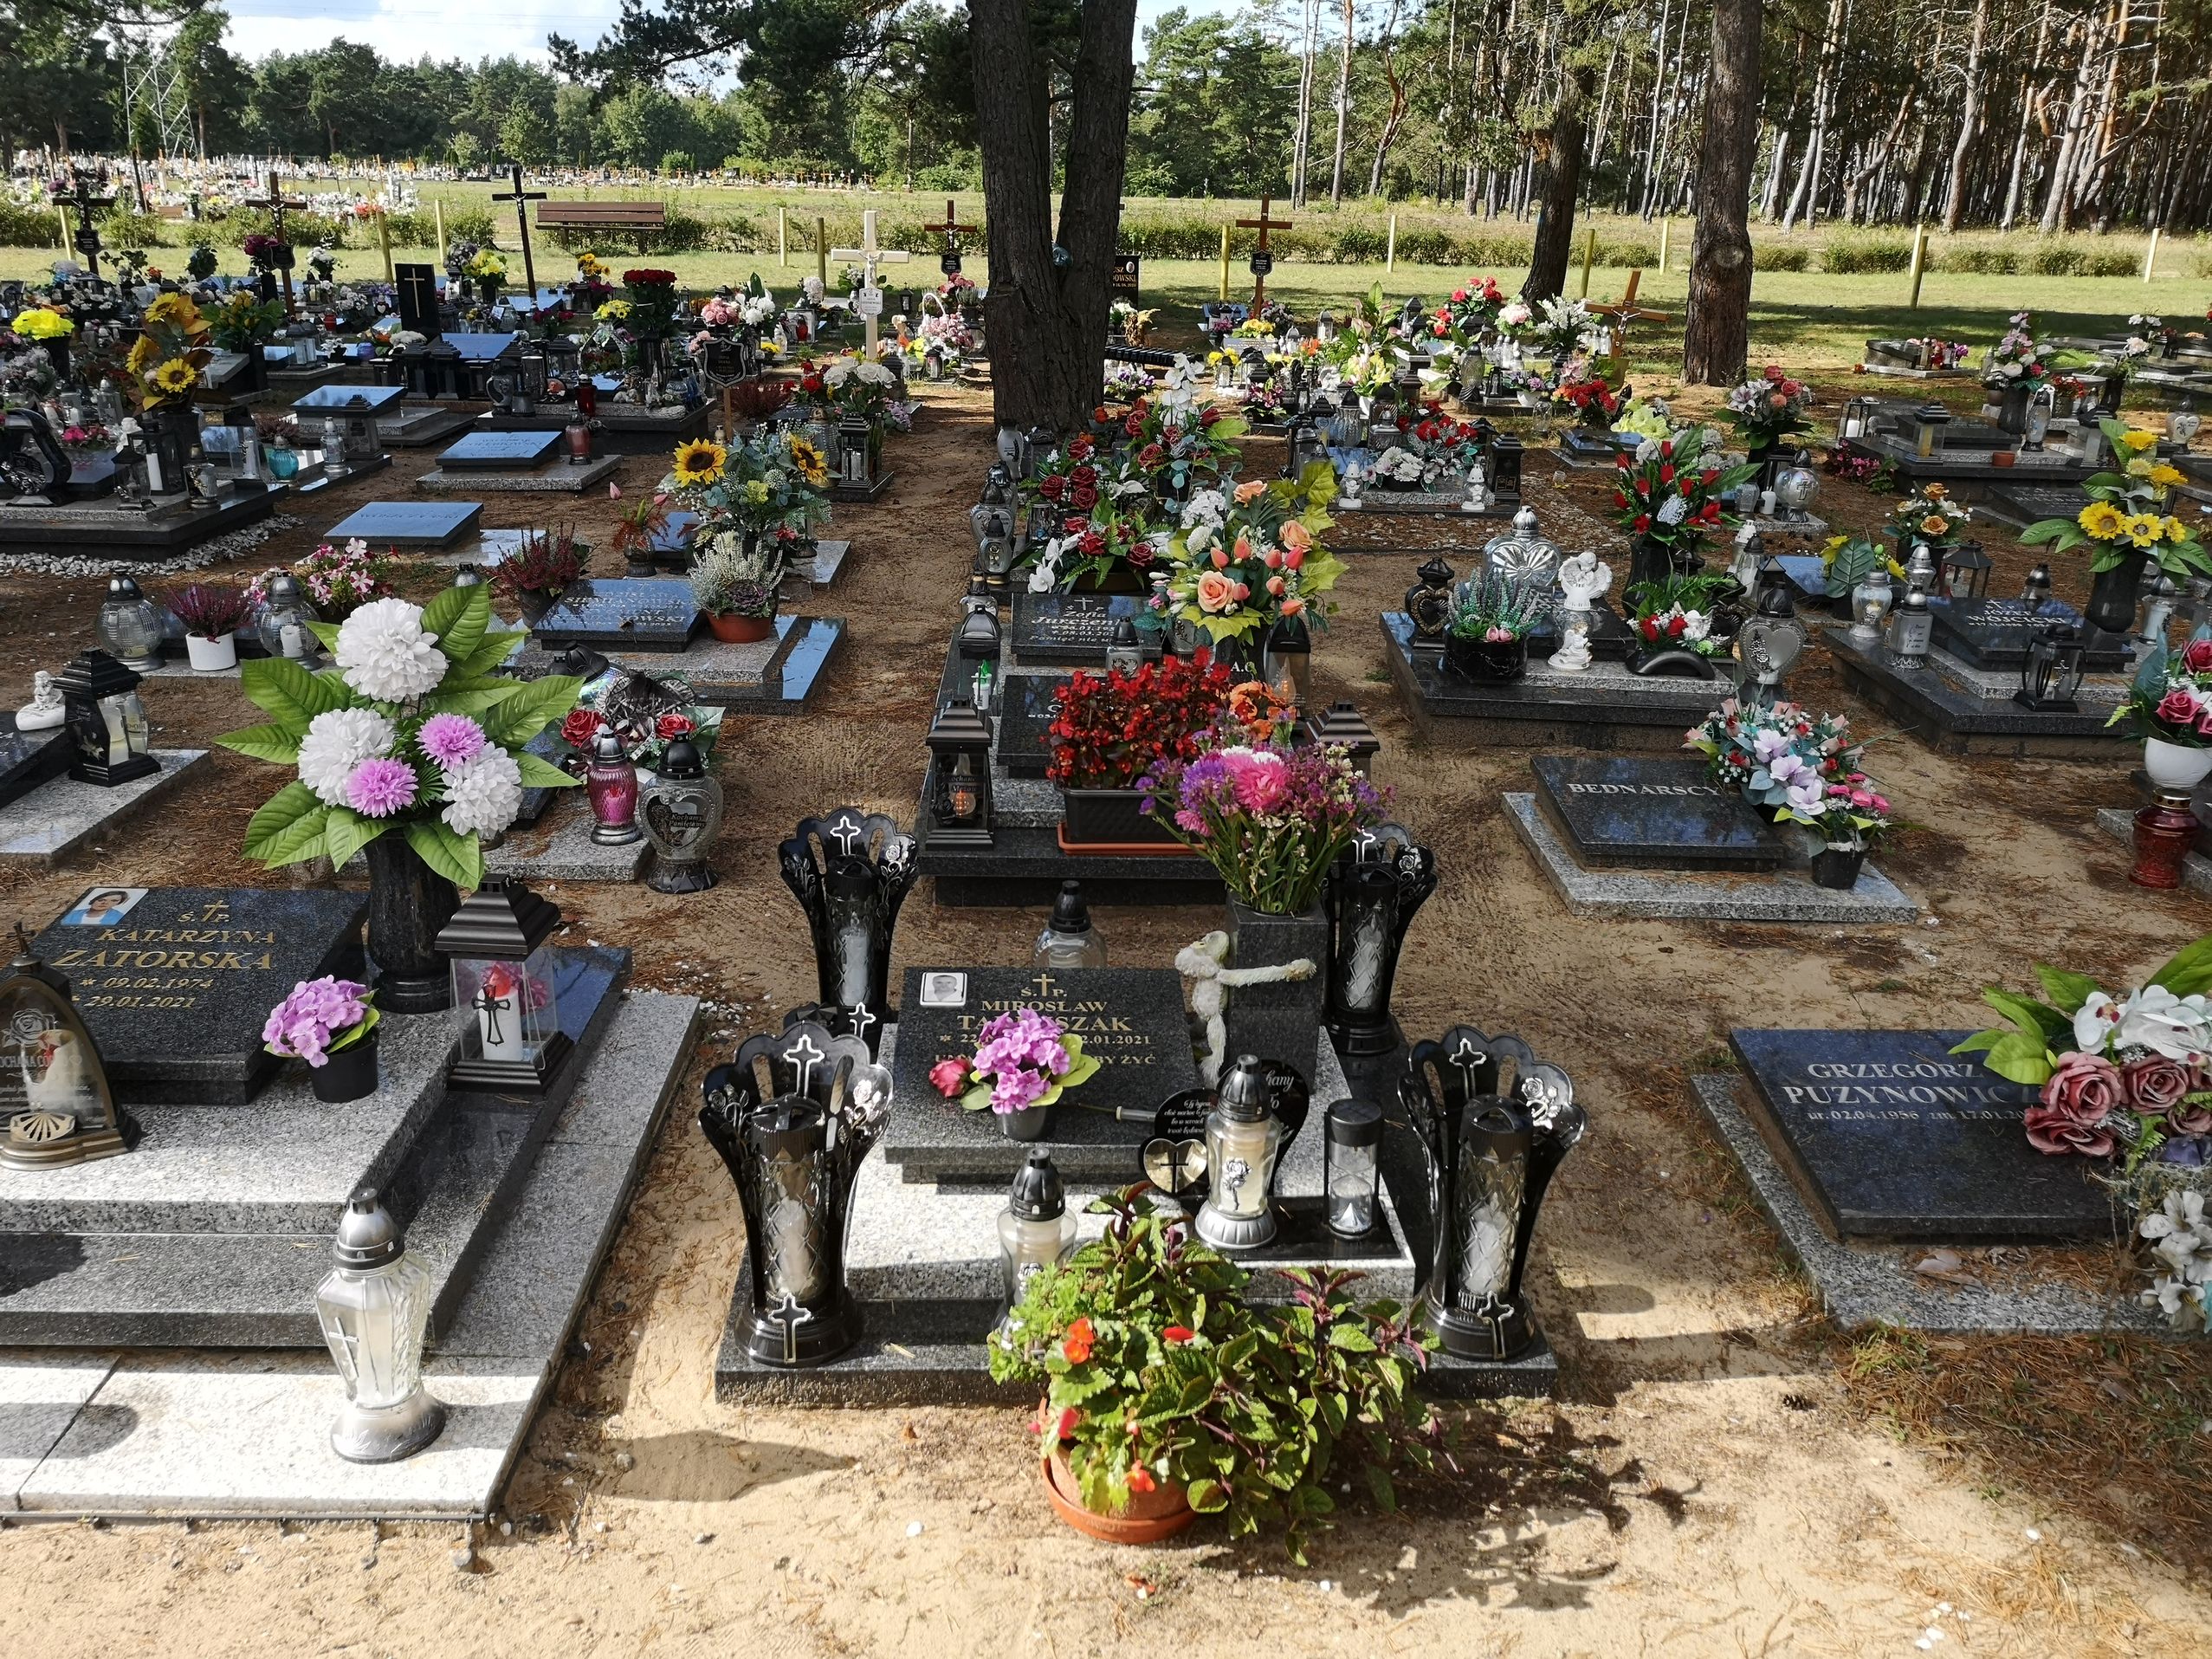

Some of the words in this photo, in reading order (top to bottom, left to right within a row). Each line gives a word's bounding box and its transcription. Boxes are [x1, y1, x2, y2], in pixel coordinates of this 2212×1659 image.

[1063, 611, 1107, 619] Zofia
[1966, 615, 2066, 624] WÓJCICKI
[1567, 783, 1722, 796] BEDNARSCY
[95, 929, 275, 943] KATARZYNA
[50, 949, 272, 969] ZATORSKA
[103, 978, 213, 989] 09.02.1974
[84, 996, 197, 1008] 29.01.2021
[980, 1000, 1109, 1012] MIROSŁAW
[1081, 1034, 1151, 1045] 2.01.2021
[1121, 1053, 1156, 1065] ŻYĆ
[1807, 1063, 1983, 1079] GRZEGORZ
